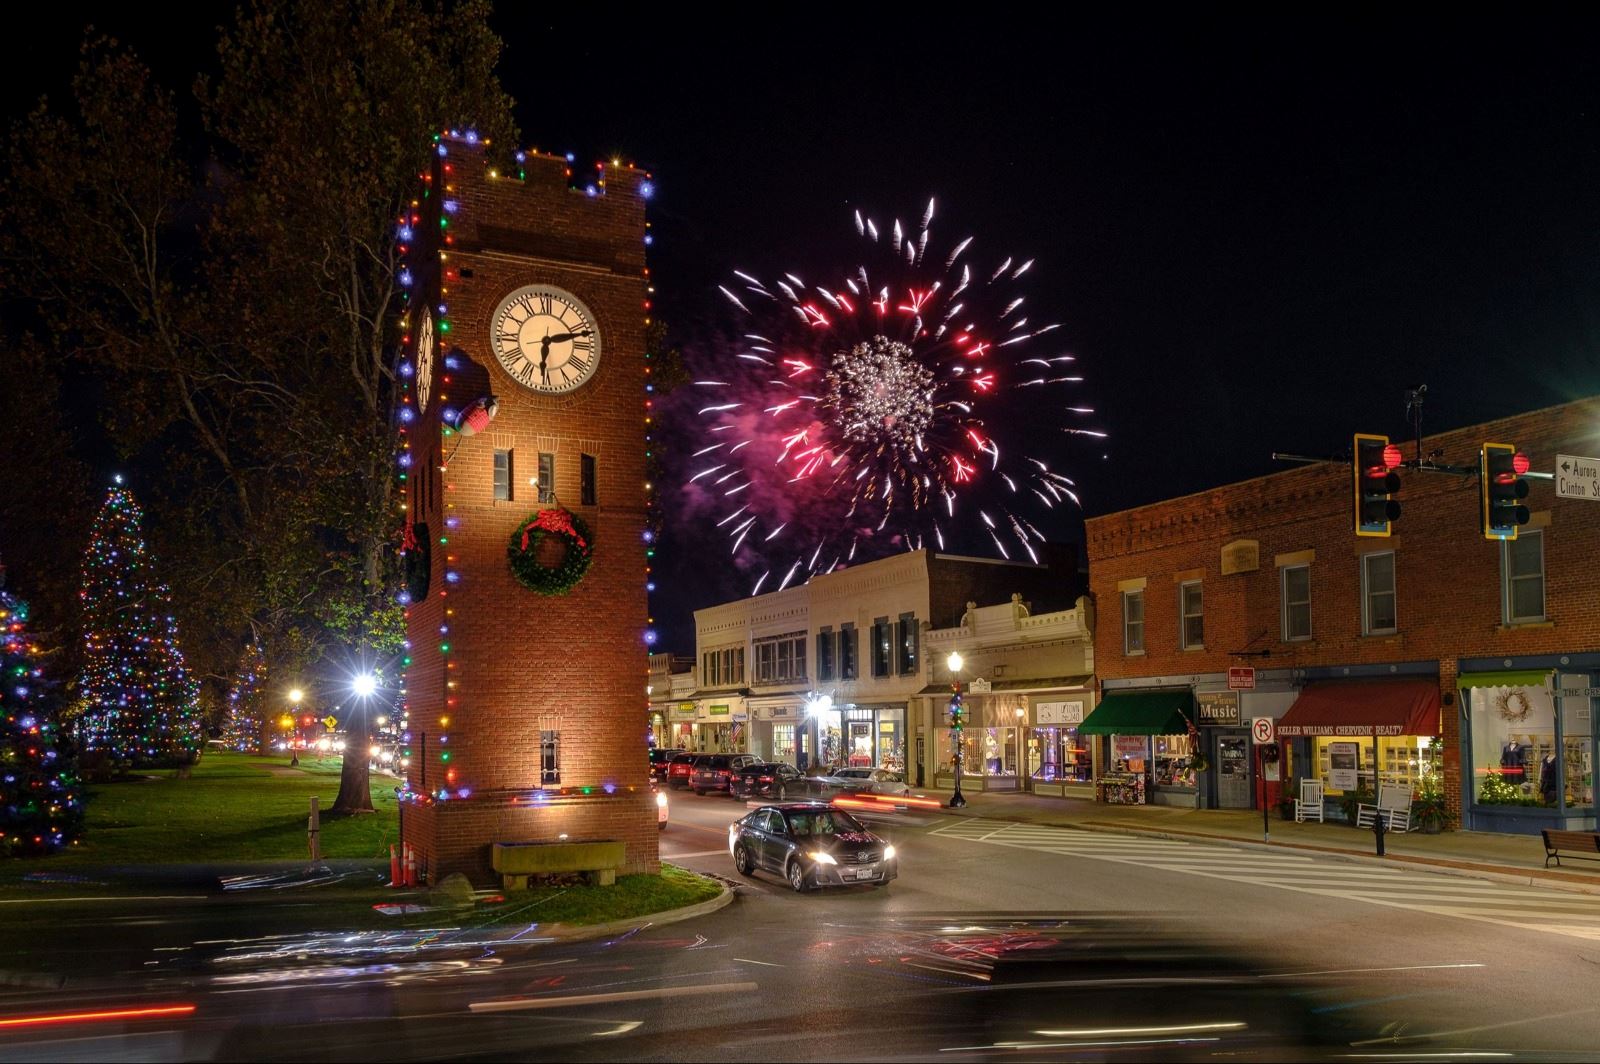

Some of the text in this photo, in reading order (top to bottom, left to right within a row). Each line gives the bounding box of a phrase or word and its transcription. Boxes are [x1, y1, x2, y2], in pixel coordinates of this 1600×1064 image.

[1573, 460, 1597, 478] Aurora
[1560, 477, 1586, 496] Clinton
[1563, 688, 1580, 697] THE
[1200, 704, 1237, 718] Music
[1277, 725, 1404, 736] KELLER WILLIAMS CHERVENIC REALTY
